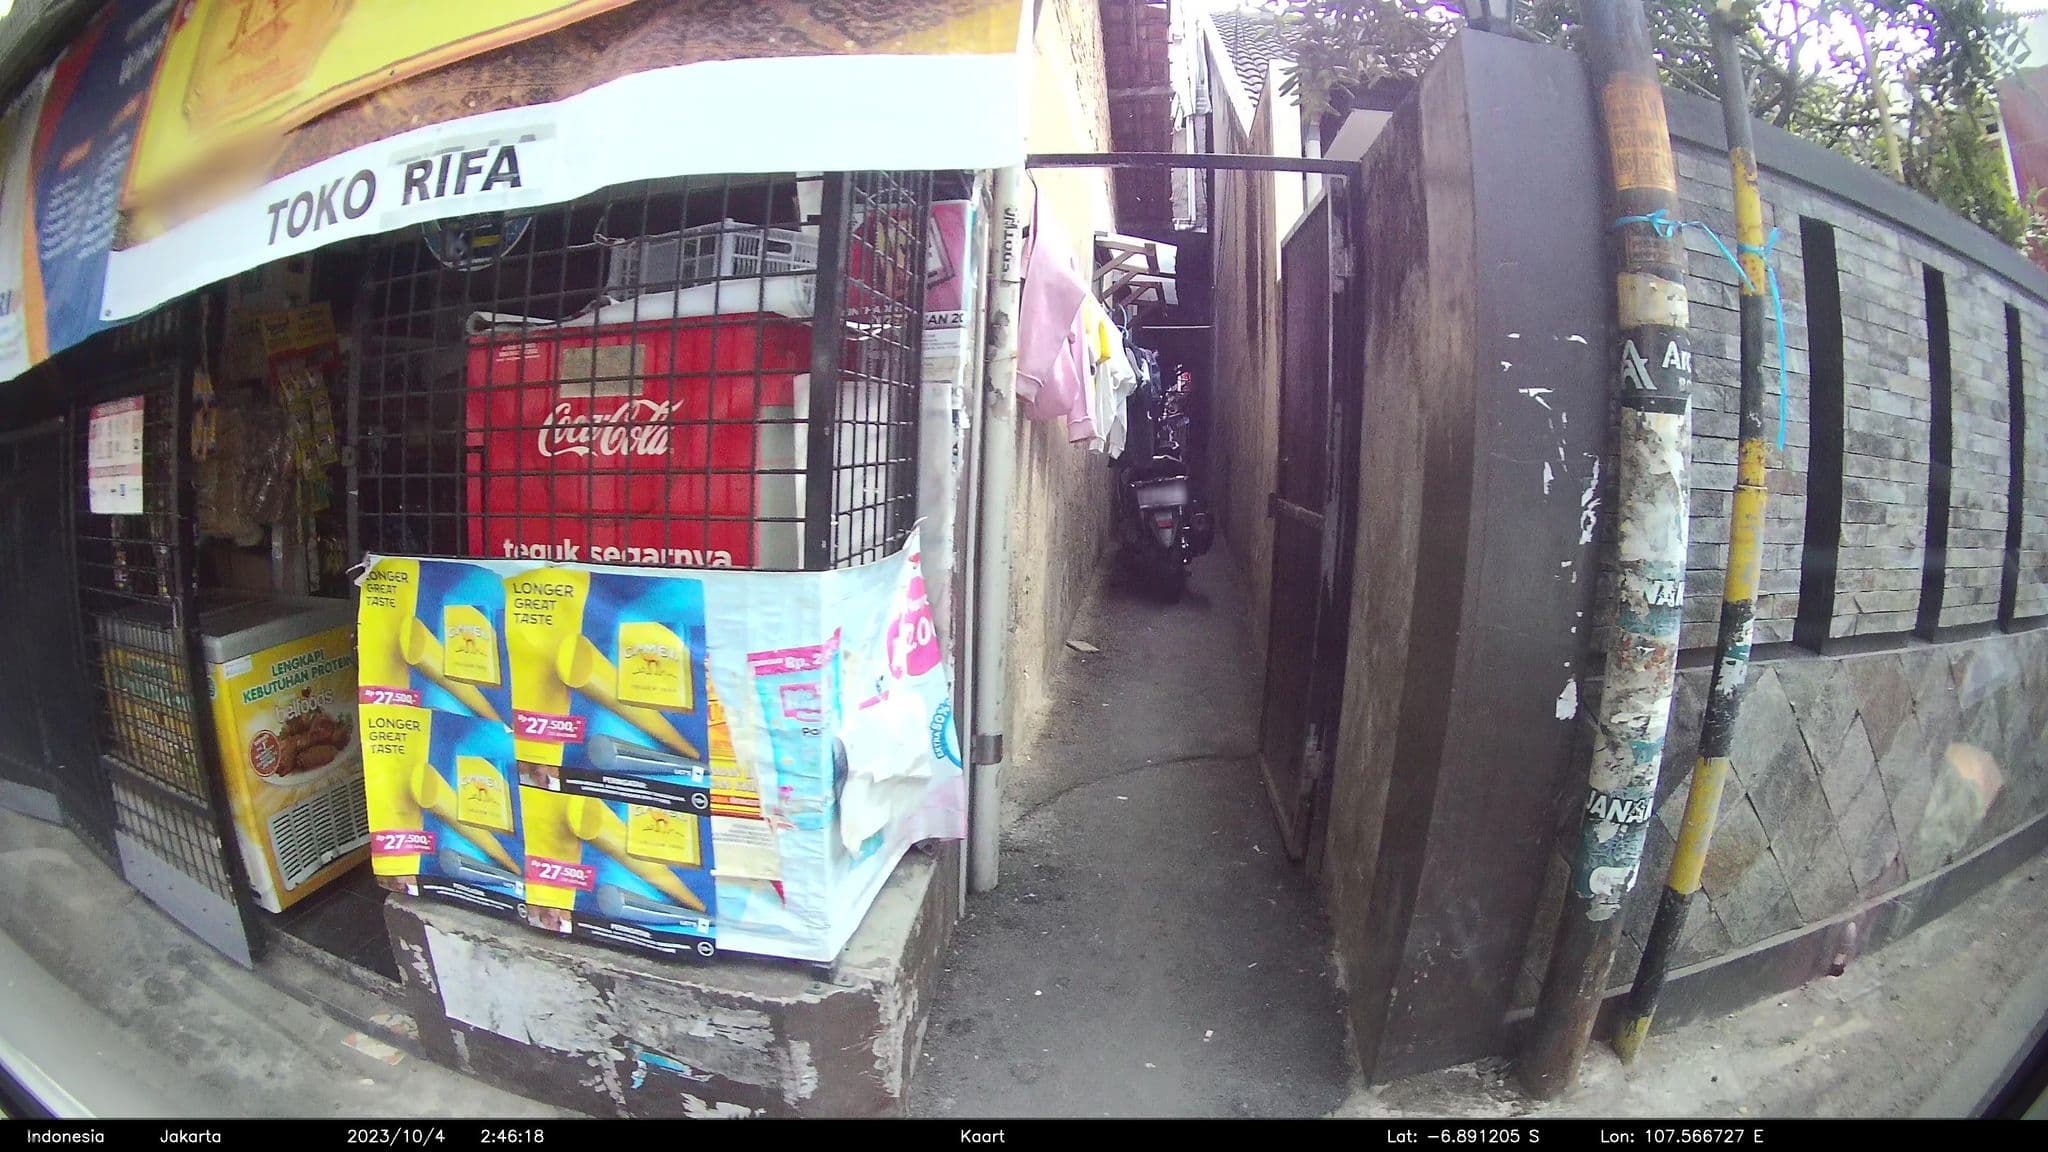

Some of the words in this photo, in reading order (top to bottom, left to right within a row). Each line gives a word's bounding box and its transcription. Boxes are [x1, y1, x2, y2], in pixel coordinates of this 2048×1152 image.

[267, 168, 376, 246] TOKO
[401, 144, 522, 206] RIFA
[503, 538, 581, 561] teguk
[590, 545, 733, 568] segarnya
[367, 583, 397, 595] GREAT
[512, 582, 575, 598] LONGER
[366, 596, 397, 608] TASTE
[514, 598, 557, 611] GREAT
[512, 612, 553, 626] TASTE
[271, 648, 325, 677] LENGKAPI
[241, 670, 310, 704] KEBUTUHAN
[311, 655, 355, 678] PROTEIN
[368, 717, 421, 732] LONGER
[369, 731, 408, 743] GREAT
[371, 744, 406, 755] TASTE
